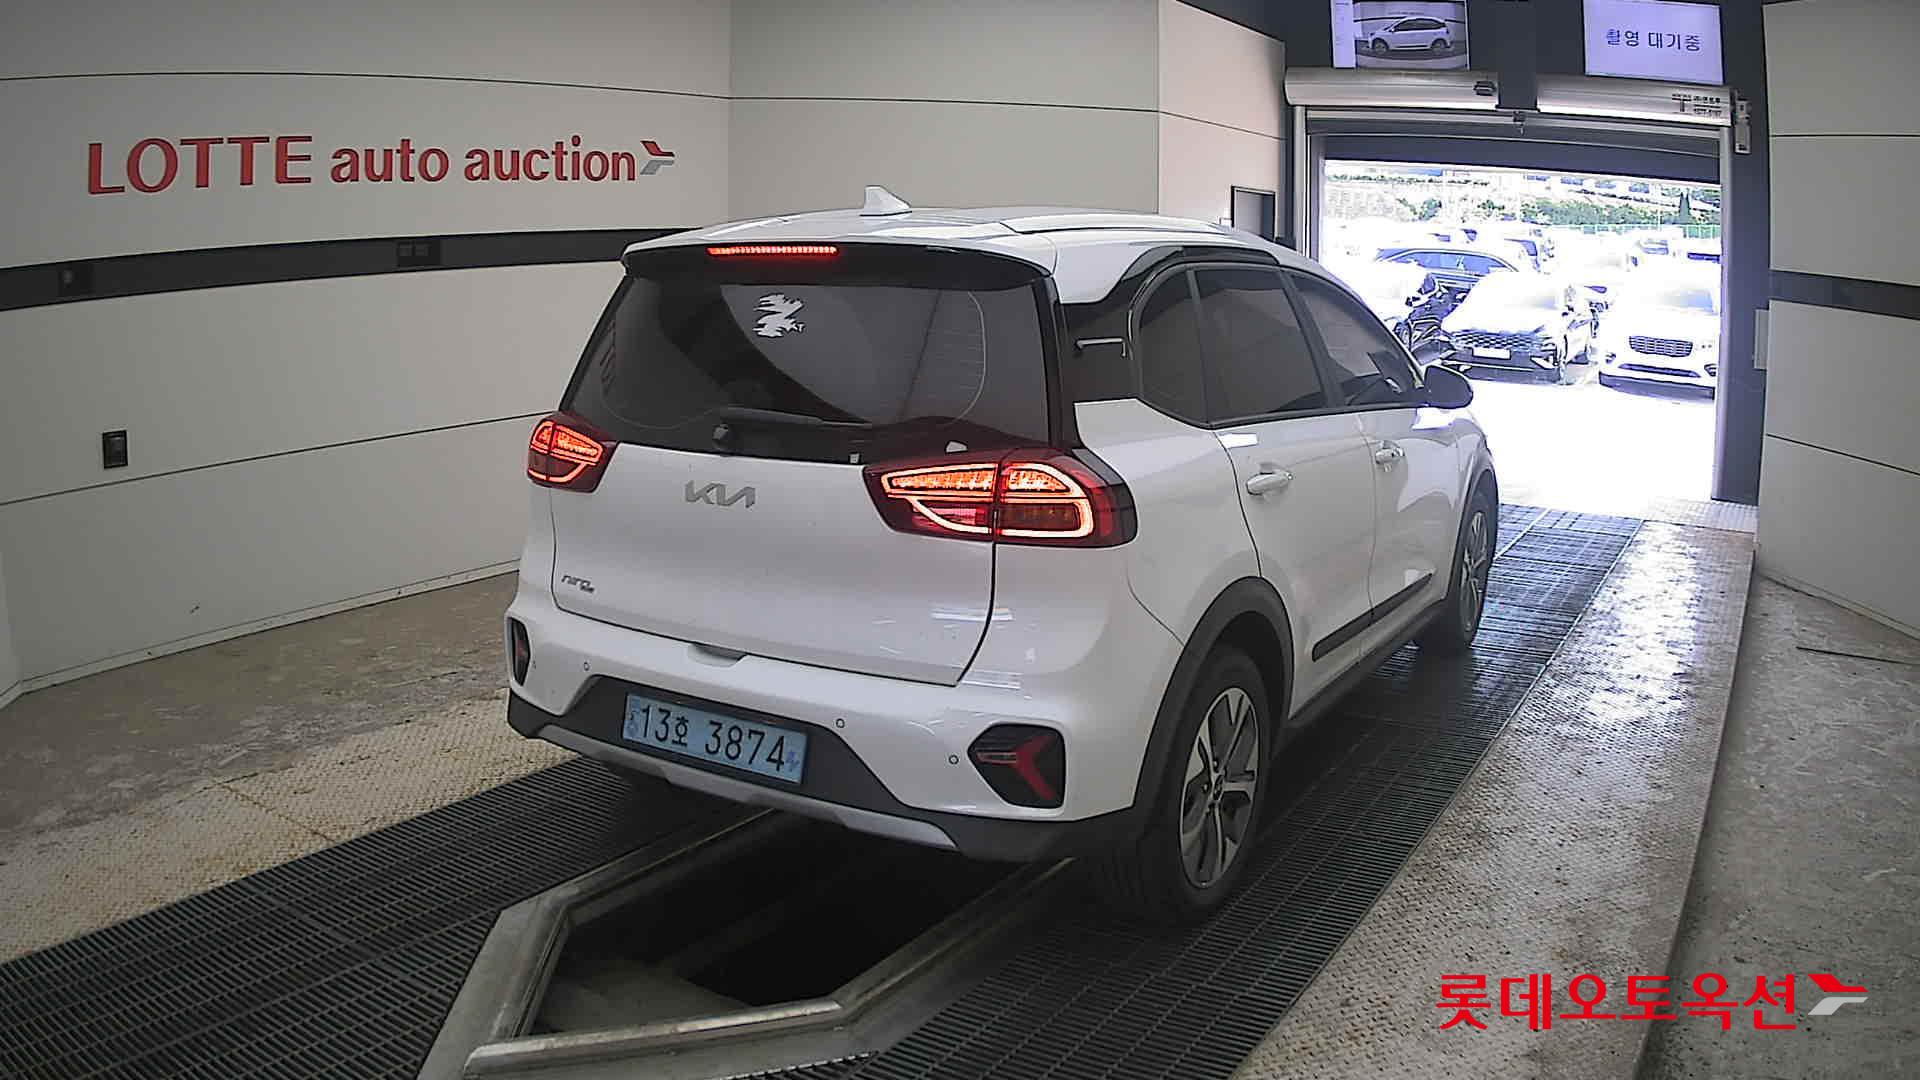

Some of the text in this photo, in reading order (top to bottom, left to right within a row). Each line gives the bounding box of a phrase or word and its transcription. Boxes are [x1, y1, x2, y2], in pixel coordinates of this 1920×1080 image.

[1647, 31, 1701, 52] 대기중
[88, 135, 636, 194] LOTTE auto auction
[640, 704, 785, 772] 13호 3874
